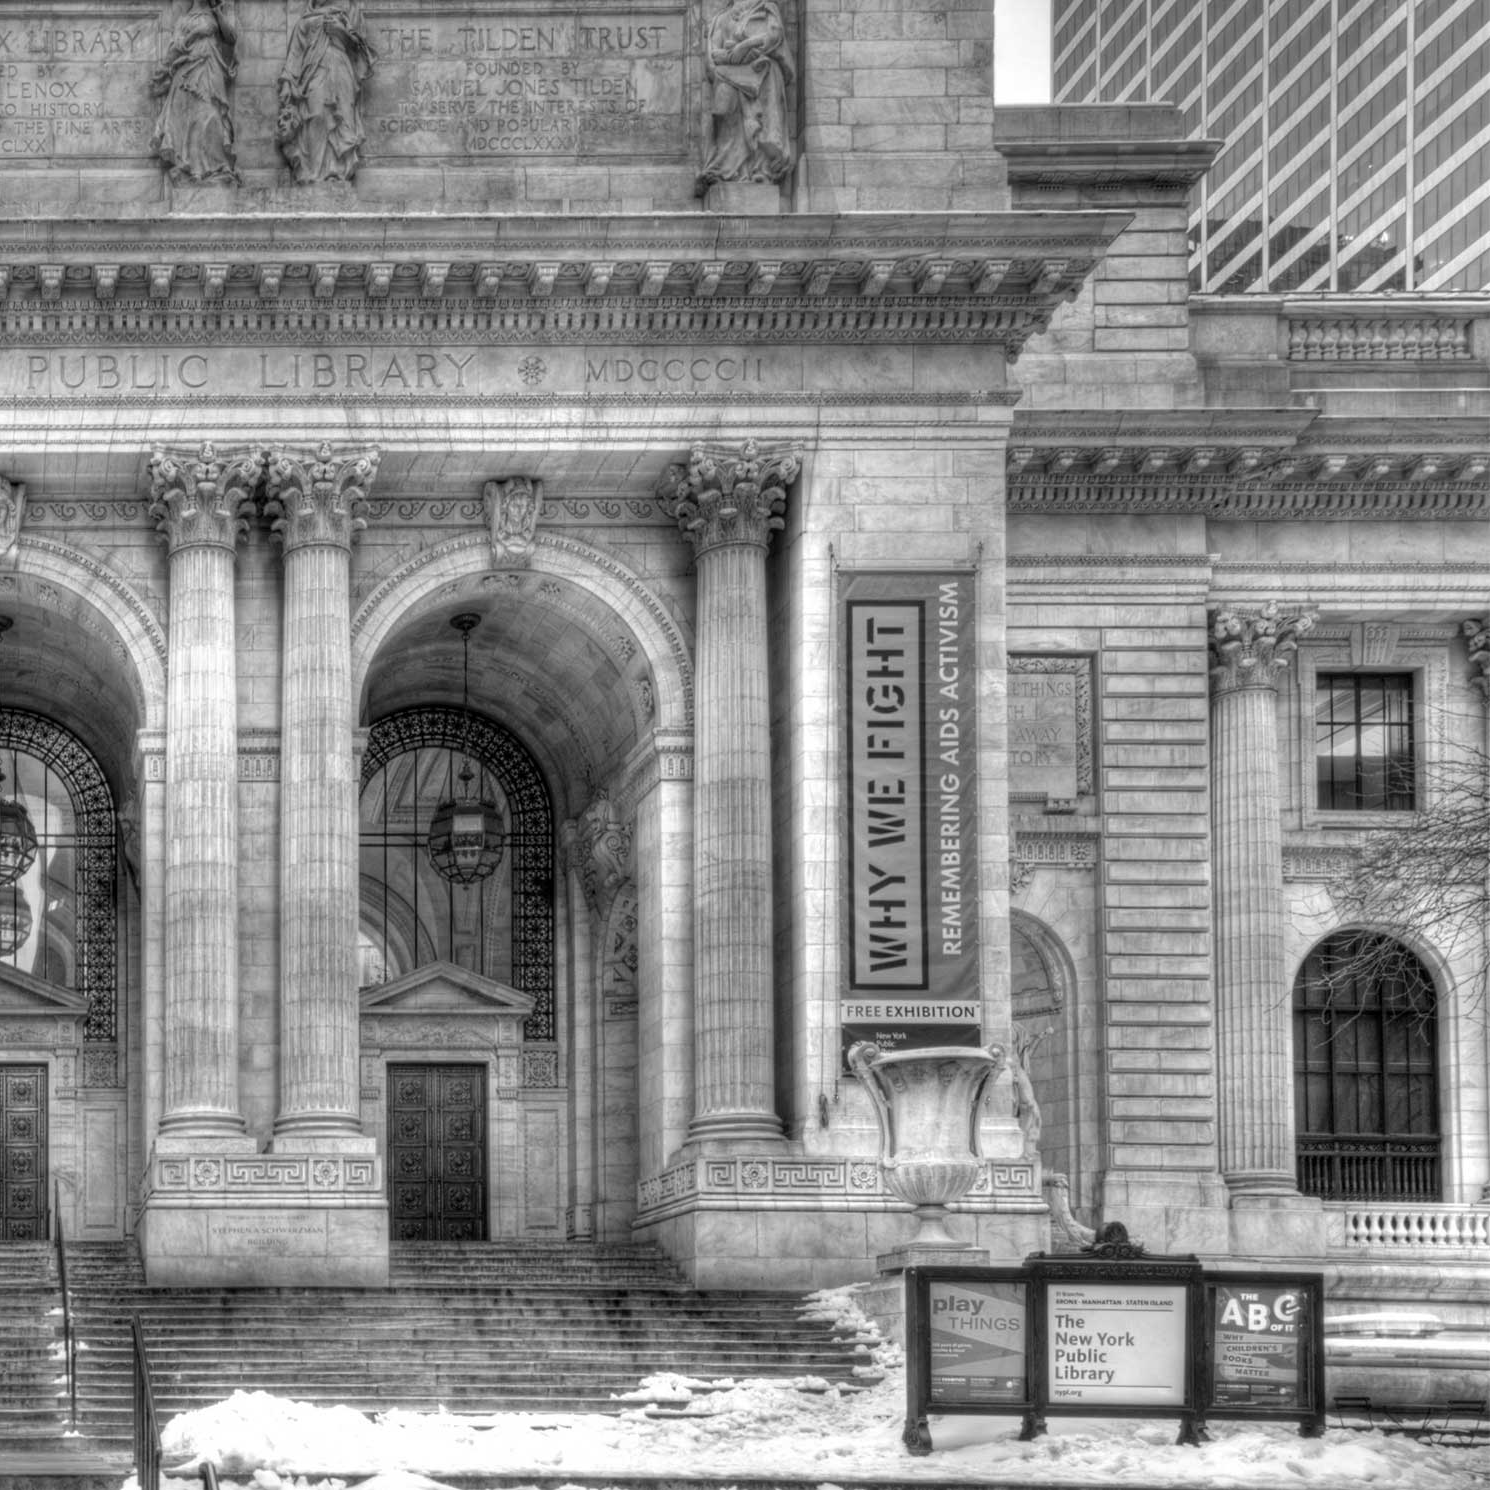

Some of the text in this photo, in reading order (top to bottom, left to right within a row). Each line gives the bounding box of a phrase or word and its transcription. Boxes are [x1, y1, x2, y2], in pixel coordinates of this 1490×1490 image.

[27, 29, 142, 55] LIBRARY
[380, 27, 668, 52] THE TILDEN TRUST
[36, 64, 56, 79] BY
[465, 61, 581, 76] FOUNDED BY
[6, 81, 79, 99] LENOX
[411, 78, 638, 97] SAMUEL JONES TILDEN
[428, 100, 478, 115] SERVE
[489, 100, 521, 115] THE
[527, 100, 616, 115] INTERESTS
[625, 100, 647, 115] OF
[13, 121, 47, 136] THE
[55, 121, 91, 136] FINE
[100, 121, 143, 136] ARTS
[379, 119, 447, 134] SCIENCE
[456, 119, 490, 134] AND
[496, 119, 572, 134] POPULAR
[25, 353, 211, 391] PUBLIC
[257, 353, 478, 390] LIBRARY
[583, 357, 767, 383] MDCCCCII
[1021, 681, 1073, 697] THINGS
[1014, 727, 1062, 742] AWAY
[938, 581, 963, 955] REMEMBERING AIDS ACTIVISM
[866, 616, 907, 973] WHY WE FIGHT
[846, 1005, 976, 1018] FREE EXHIBITION
[876, 1031, 908, 1040] New York
[876, 1039, 896, 1048] Public
[1125, 1299, 1149, 1307] STATEN
[1149, 1299, 1174, 1307] ISLAND
[1239, 1293, 1259, 1301] THE
[932, 1295, 985, 1316] play
[948, 1316, 1021, 1331] THINGS
[1054, 1314, 1085, 1329] The
[1270, 1323, 1296, 1332] OF IT
[1055, 1331, 1135, 1347] New York
[1222, 1333, 1244, 1341] WHY
[1055, 1348, 1107, 1363] Public
[1226, 1344, 1278, 1353] CHILDREN'S
[1222, 1354, 1253, 1365] BOOKS
[1055, 1365, 1115, 1384] Library
[1234, 1367, 1270, 1377] MATTER
[1054, 1389, 1083, 1398] nypl.org
